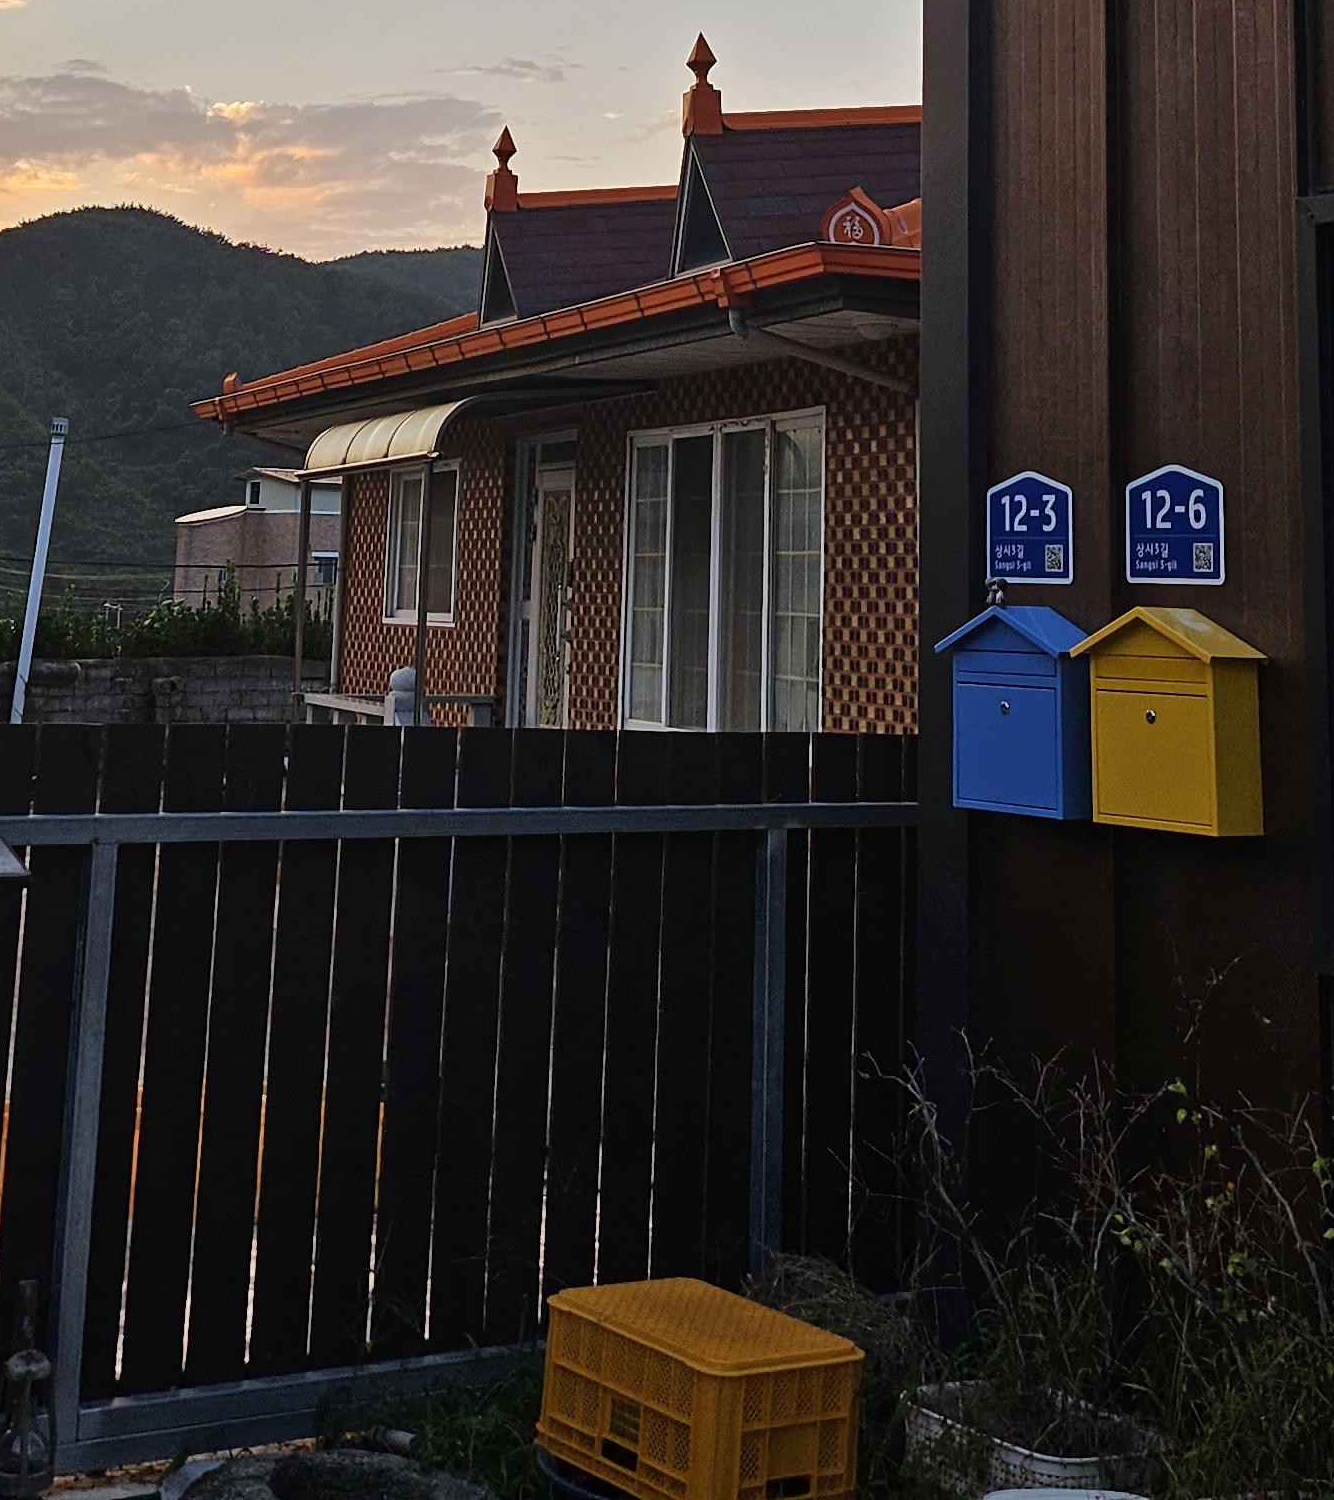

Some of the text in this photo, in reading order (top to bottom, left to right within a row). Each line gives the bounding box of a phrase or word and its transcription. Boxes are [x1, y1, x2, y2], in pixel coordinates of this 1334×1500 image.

[842, 215, 864, 240] 福
[1000, 494, 1057, 532] 12-3
[1141, 488, 1207, 530] 12-6
[994, 543, 1024, 559] 상시3길
[1135, 542, 1169, 559] 상시3길
[1135, 559, 1159, 572] Sangsi
